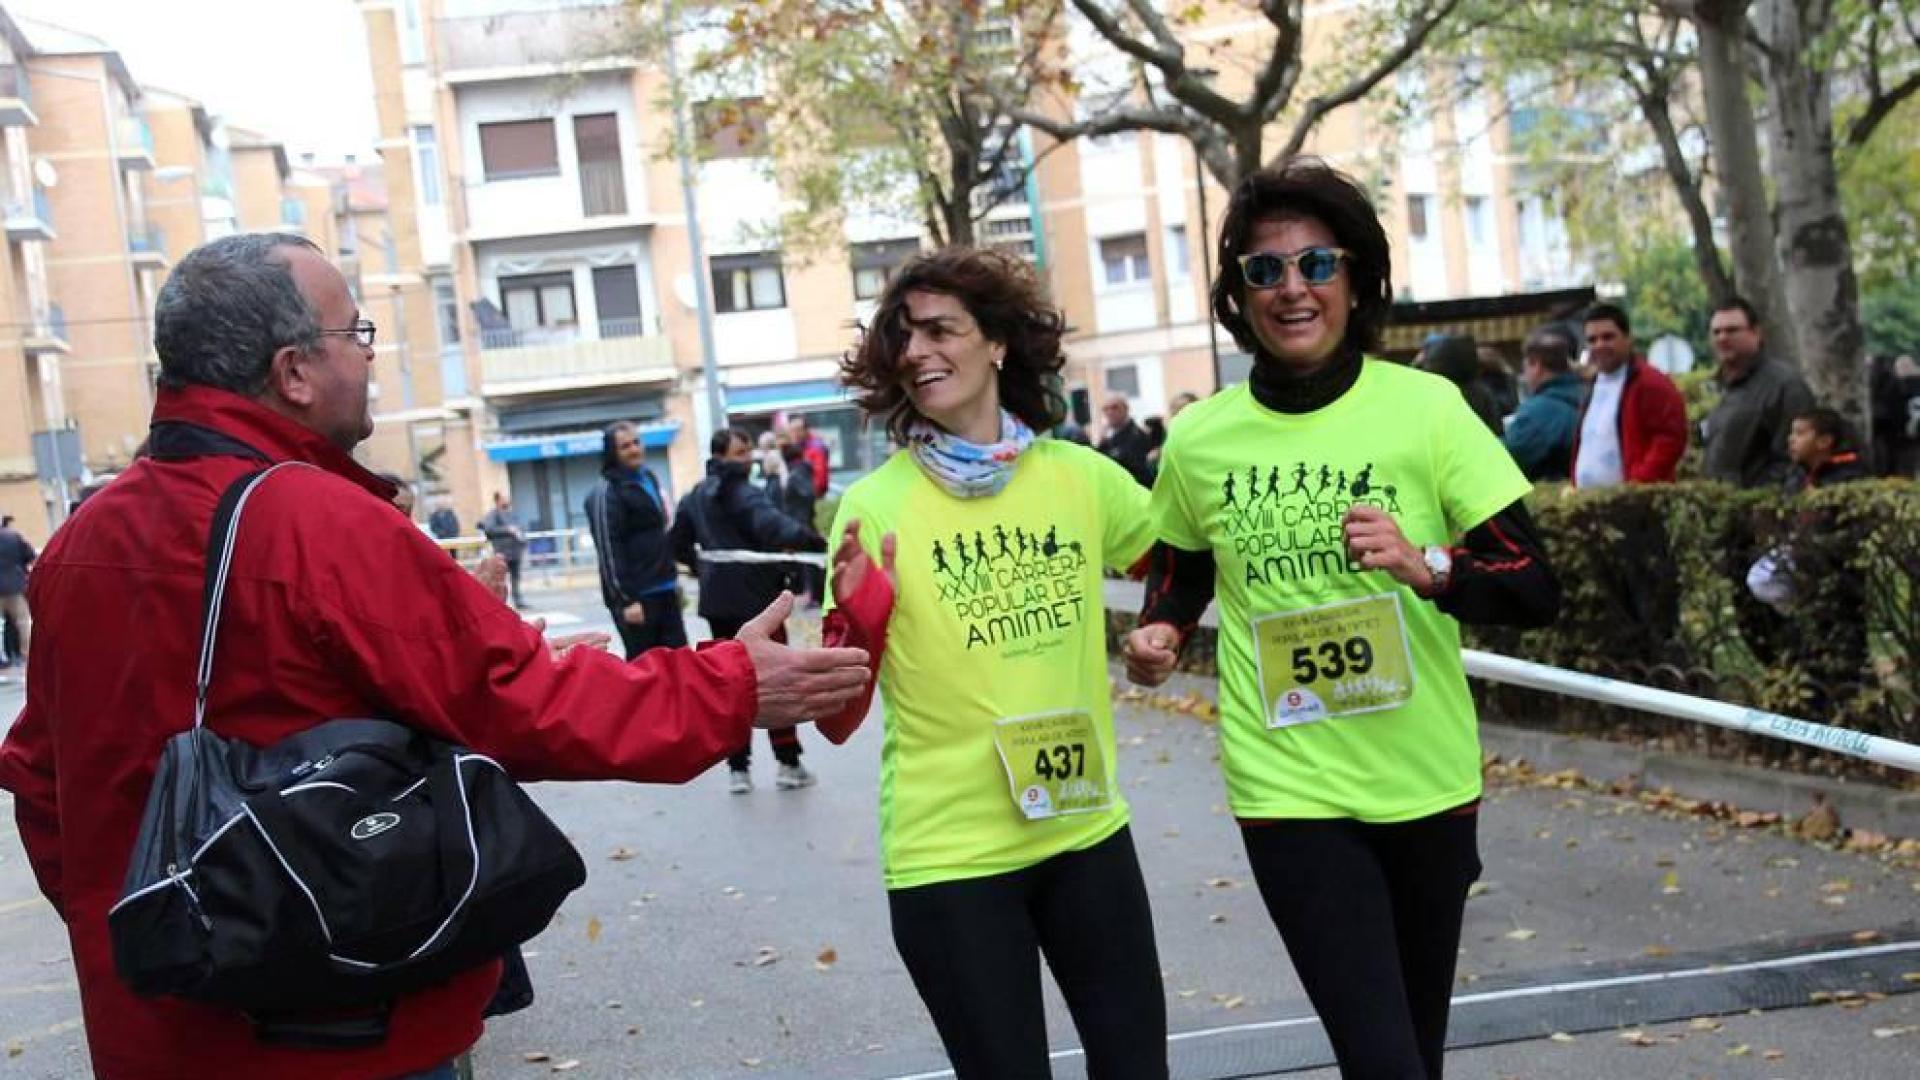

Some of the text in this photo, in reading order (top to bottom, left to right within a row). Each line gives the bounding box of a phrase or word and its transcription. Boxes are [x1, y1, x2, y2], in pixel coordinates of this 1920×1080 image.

[996, 552, 1087, 589] CARRERA
[956, 575, 1082, 620] POPULAR DE
[967, 597, 1083, 650] AMIMET
[1291, 635, 1374, 685] 539
[1035, 743, 1085, 781] 437
